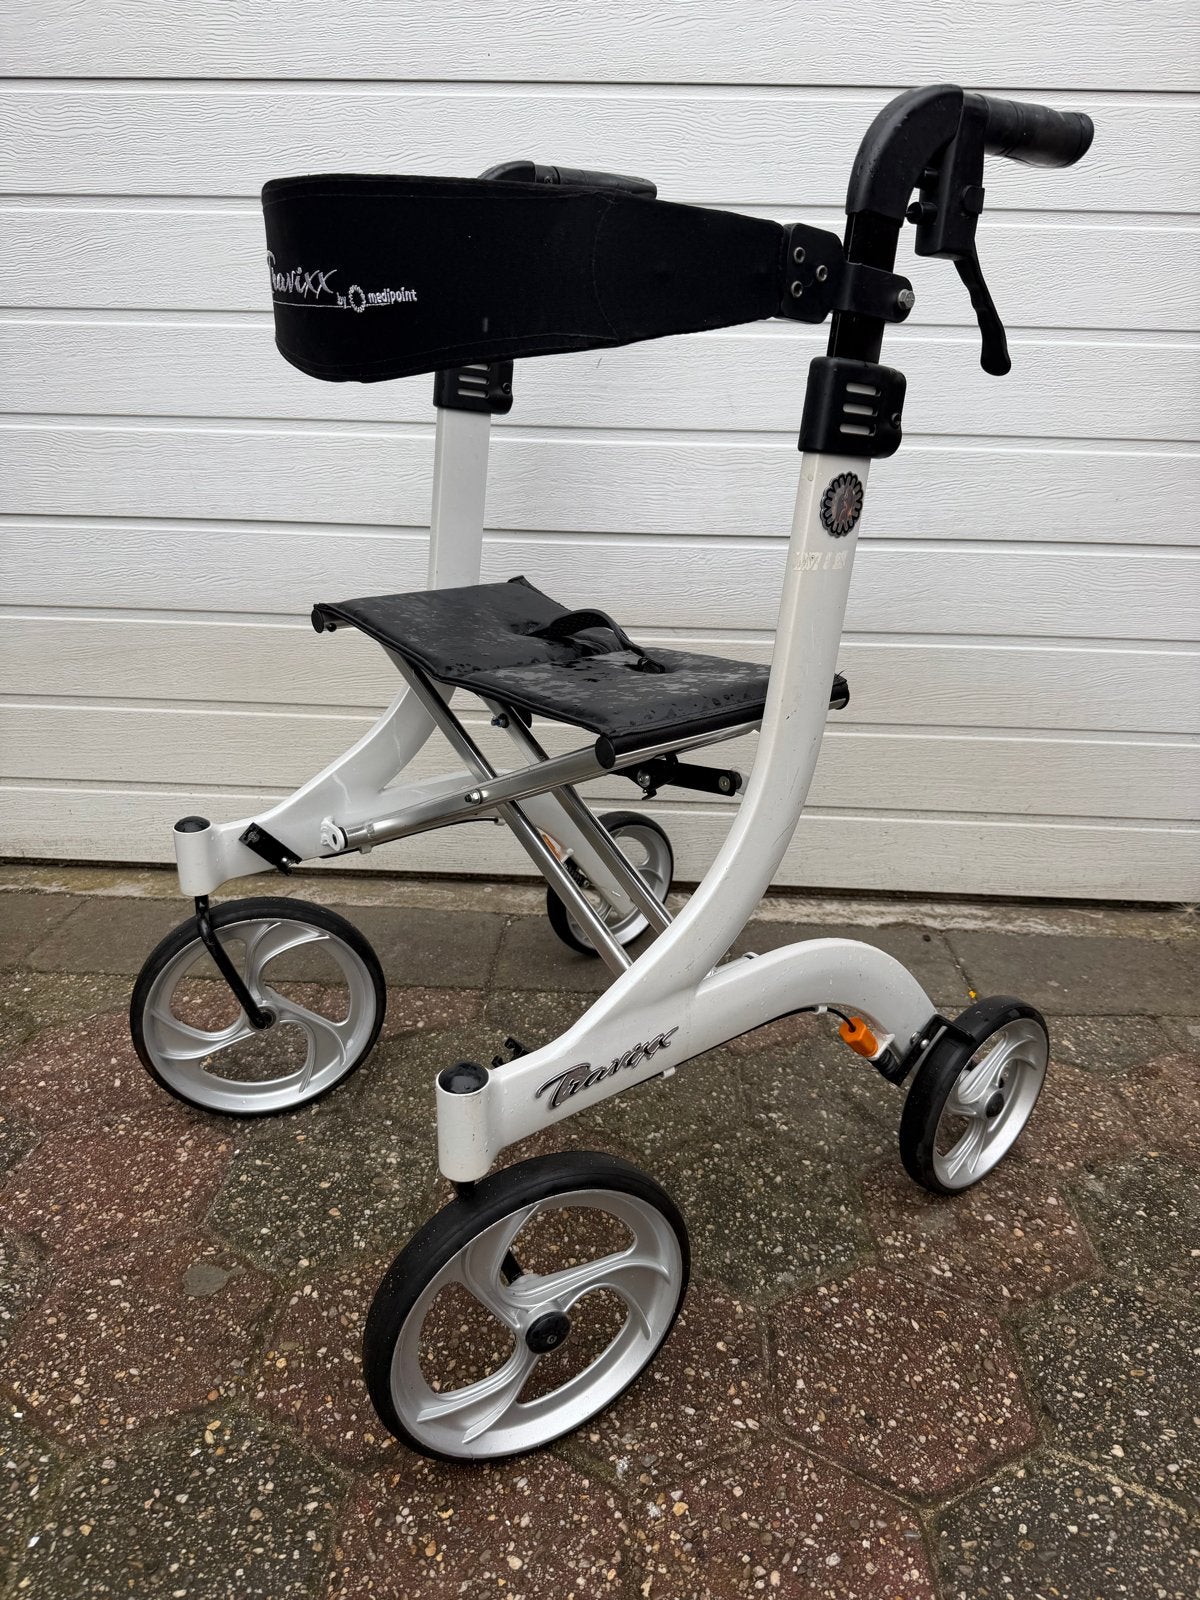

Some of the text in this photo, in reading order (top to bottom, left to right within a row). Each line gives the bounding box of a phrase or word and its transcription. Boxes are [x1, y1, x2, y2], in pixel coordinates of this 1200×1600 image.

[336, 292, 347, 309] by
[367, 286, 418, 305] medipoint
[535, 1025, 680, 1110] Travixx
